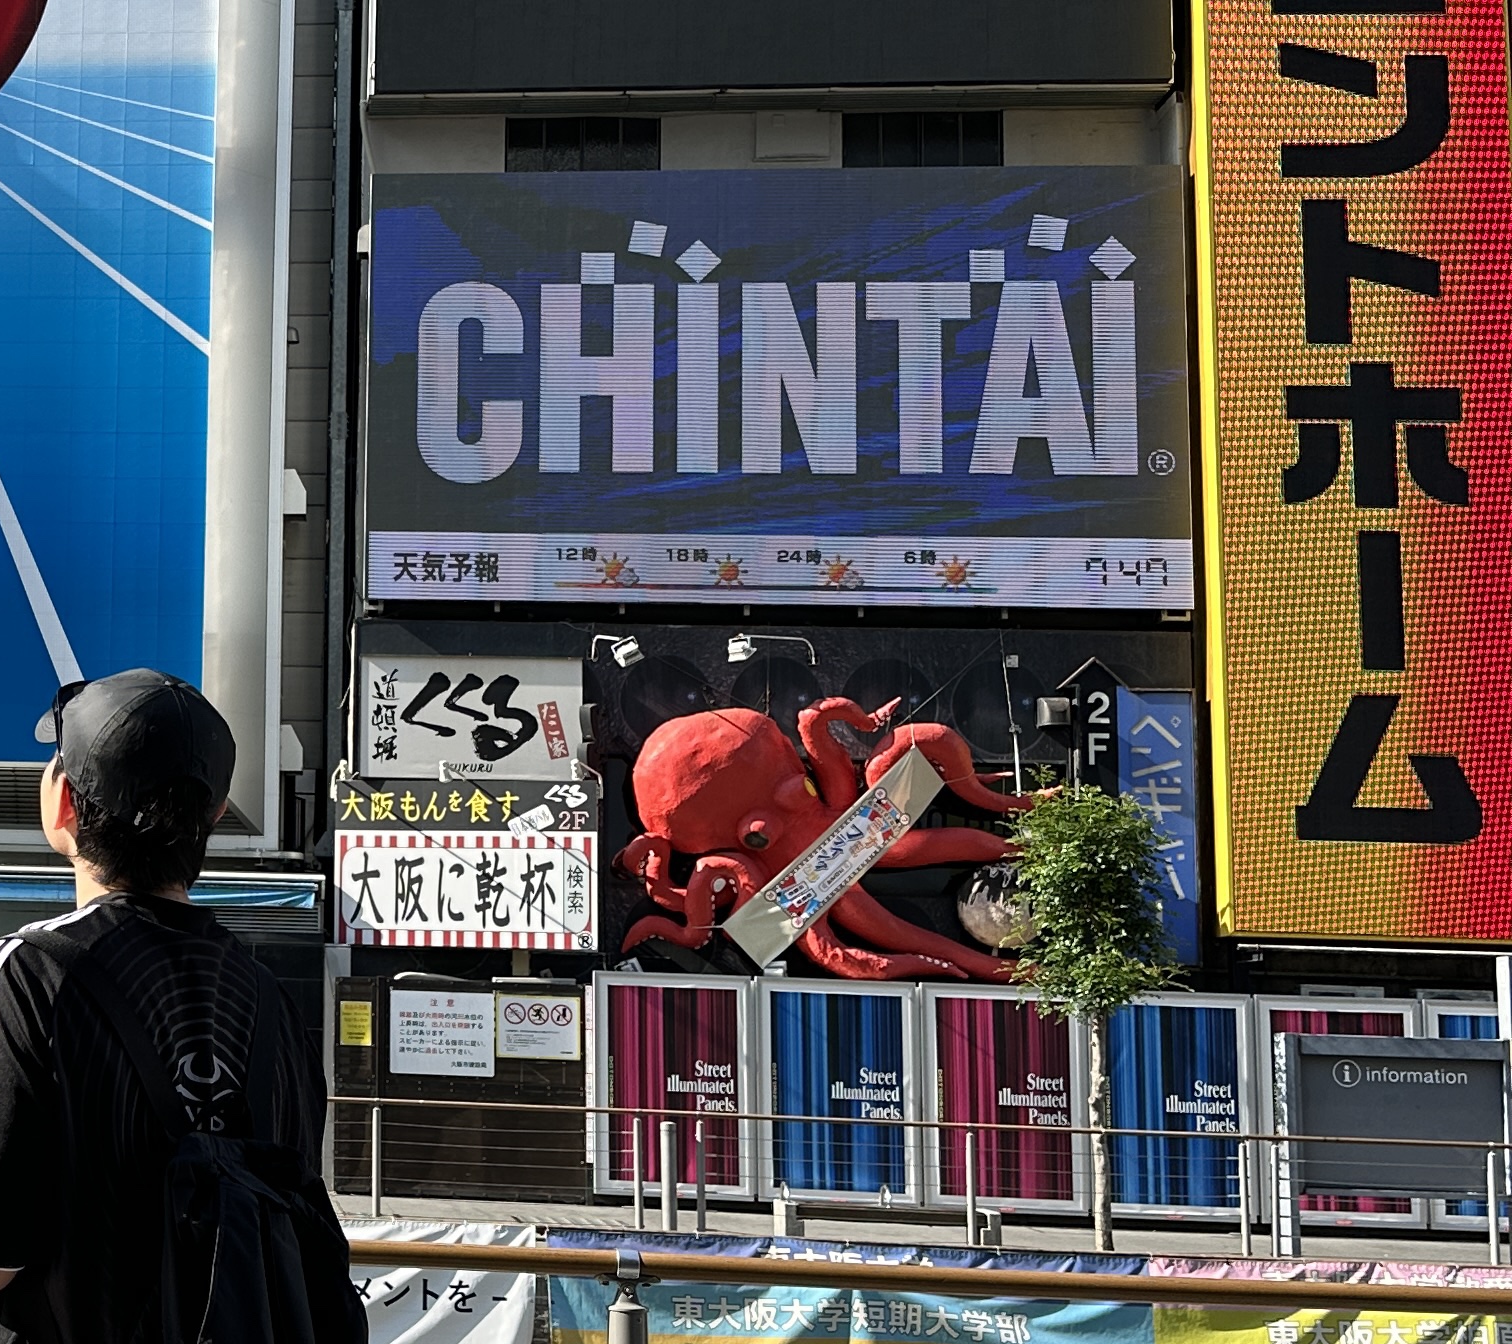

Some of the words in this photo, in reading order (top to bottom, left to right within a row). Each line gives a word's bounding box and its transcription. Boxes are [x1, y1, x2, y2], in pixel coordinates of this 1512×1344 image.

[555, 547, 598, 562] 12時
[665, 548, 709, 564] 18時
[776, 549, 823, 565] 24時
[903, 550, 938, 565] 6時
[391, 550, 502, 585] 天気予報
[371, 668, 399, 762] 道頓堀
[399, 671, 539, 762] くくる
[339, 789, 520, 824] 大阪もんを食す
[558, 811, 590, 831] 2F
[349, 851, 556, 930] 大阪に乾杯
[566, 864, 585, 915] 検索
[695, 1059, 732, 1078] Street
[859, 1066, 897, 1085] Street
[1365, 1065, 1468, 1086] information
[1025, 1072, 1065, 1092] Street
[1193, 1078, 1233, 1099] Street
[695, 1094, 737, 1113] Panels.
[860, 1101, 904, 1120] Panels.
[1028, 1107, 1072, 1127] Panels.
[1196, 1113, 1239, 1134] Panels.
